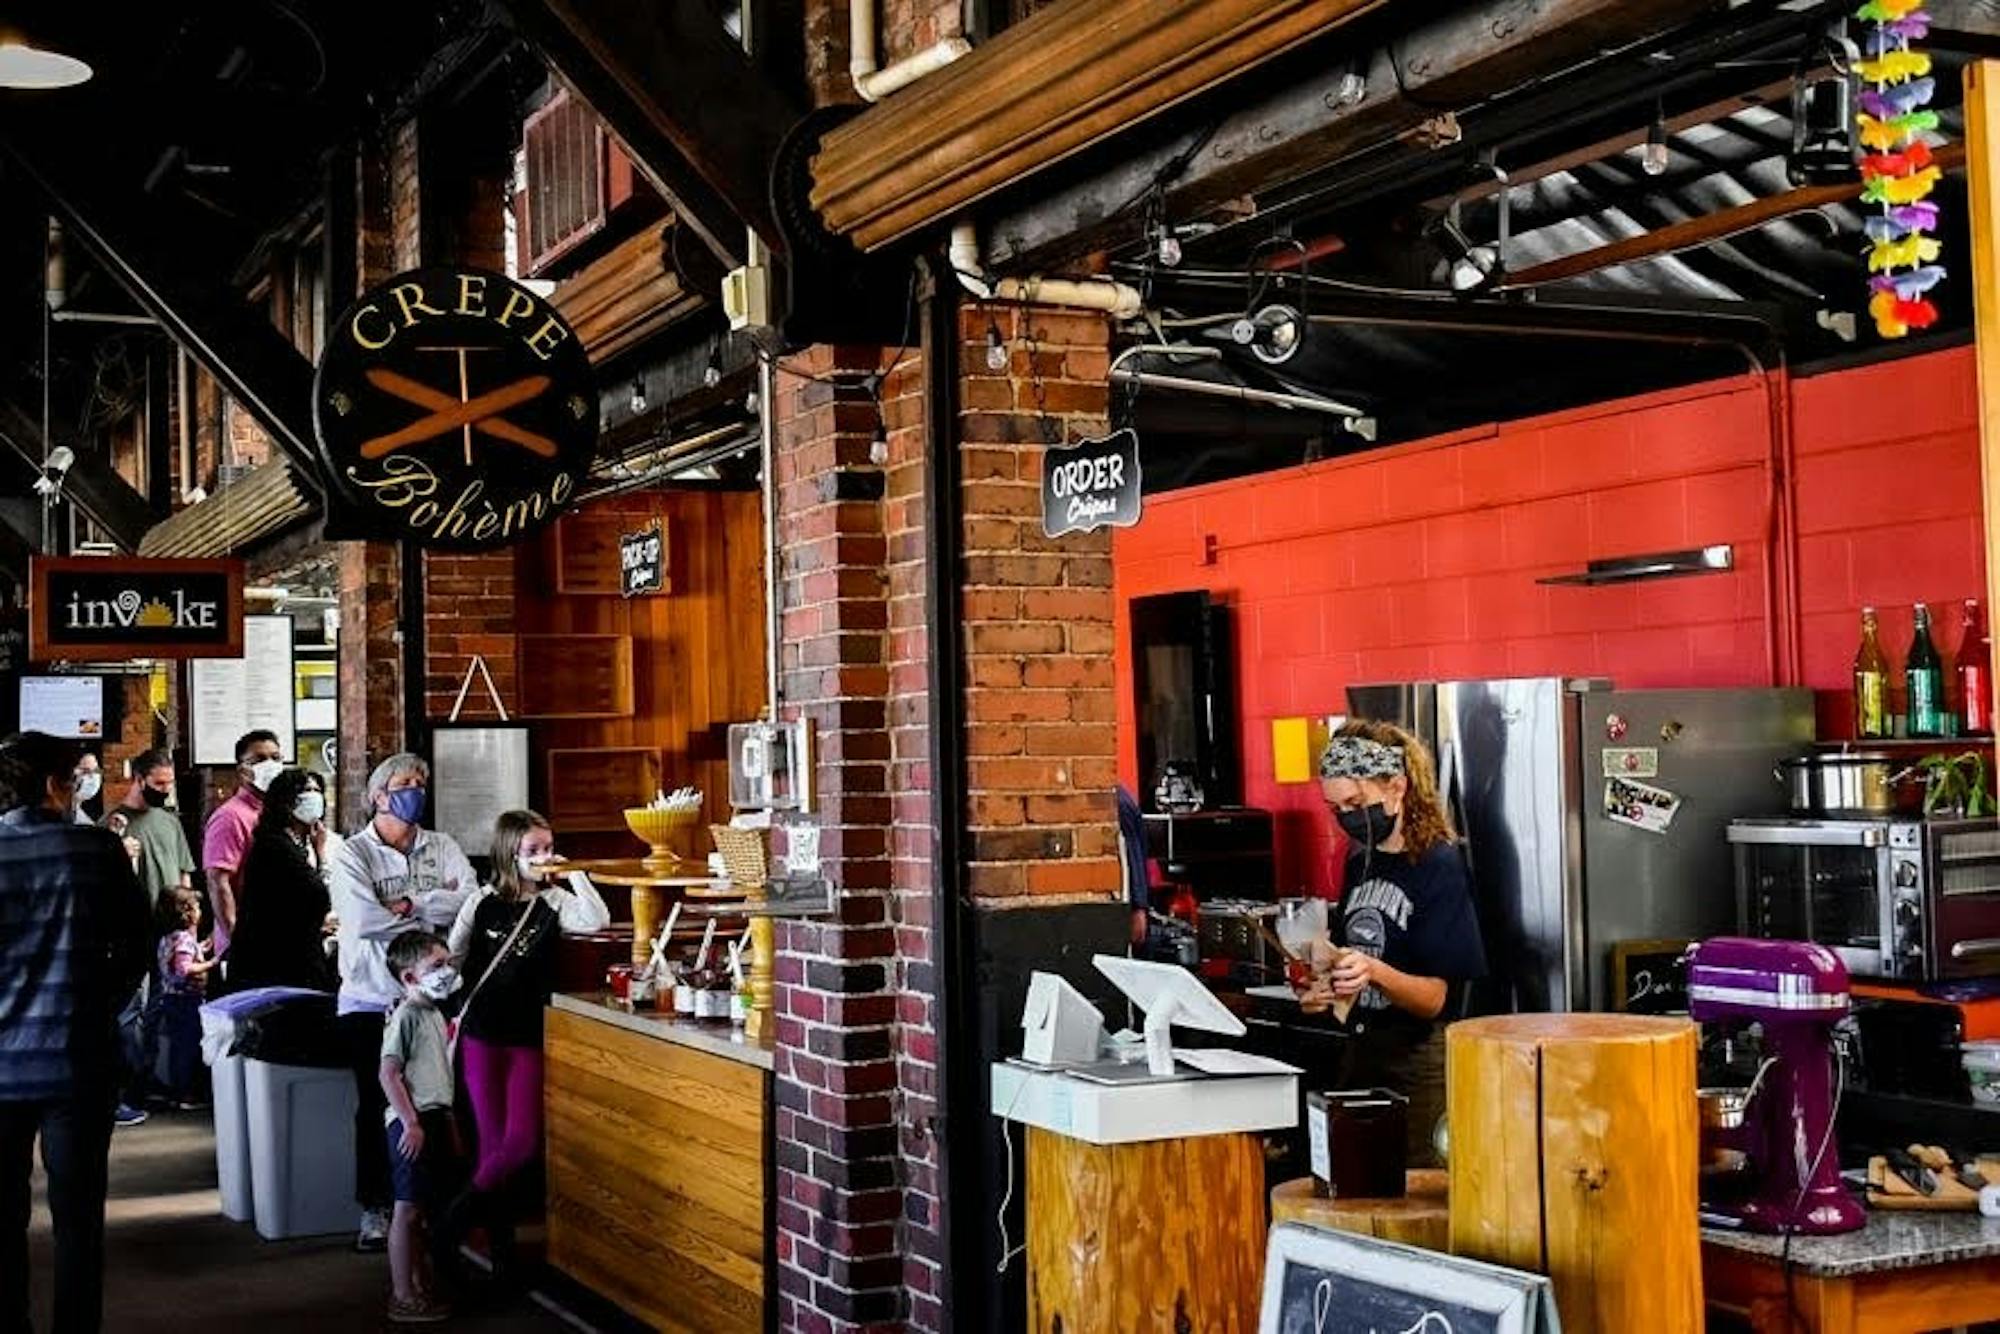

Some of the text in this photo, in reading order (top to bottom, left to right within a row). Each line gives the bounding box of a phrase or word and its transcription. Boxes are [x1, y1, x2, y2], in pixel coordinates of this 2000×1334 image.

[352, 274, 568, 361] CREPE
[346, 455, 573, 540] Bohème
[1052, 453, 1126, 498] ORDER
